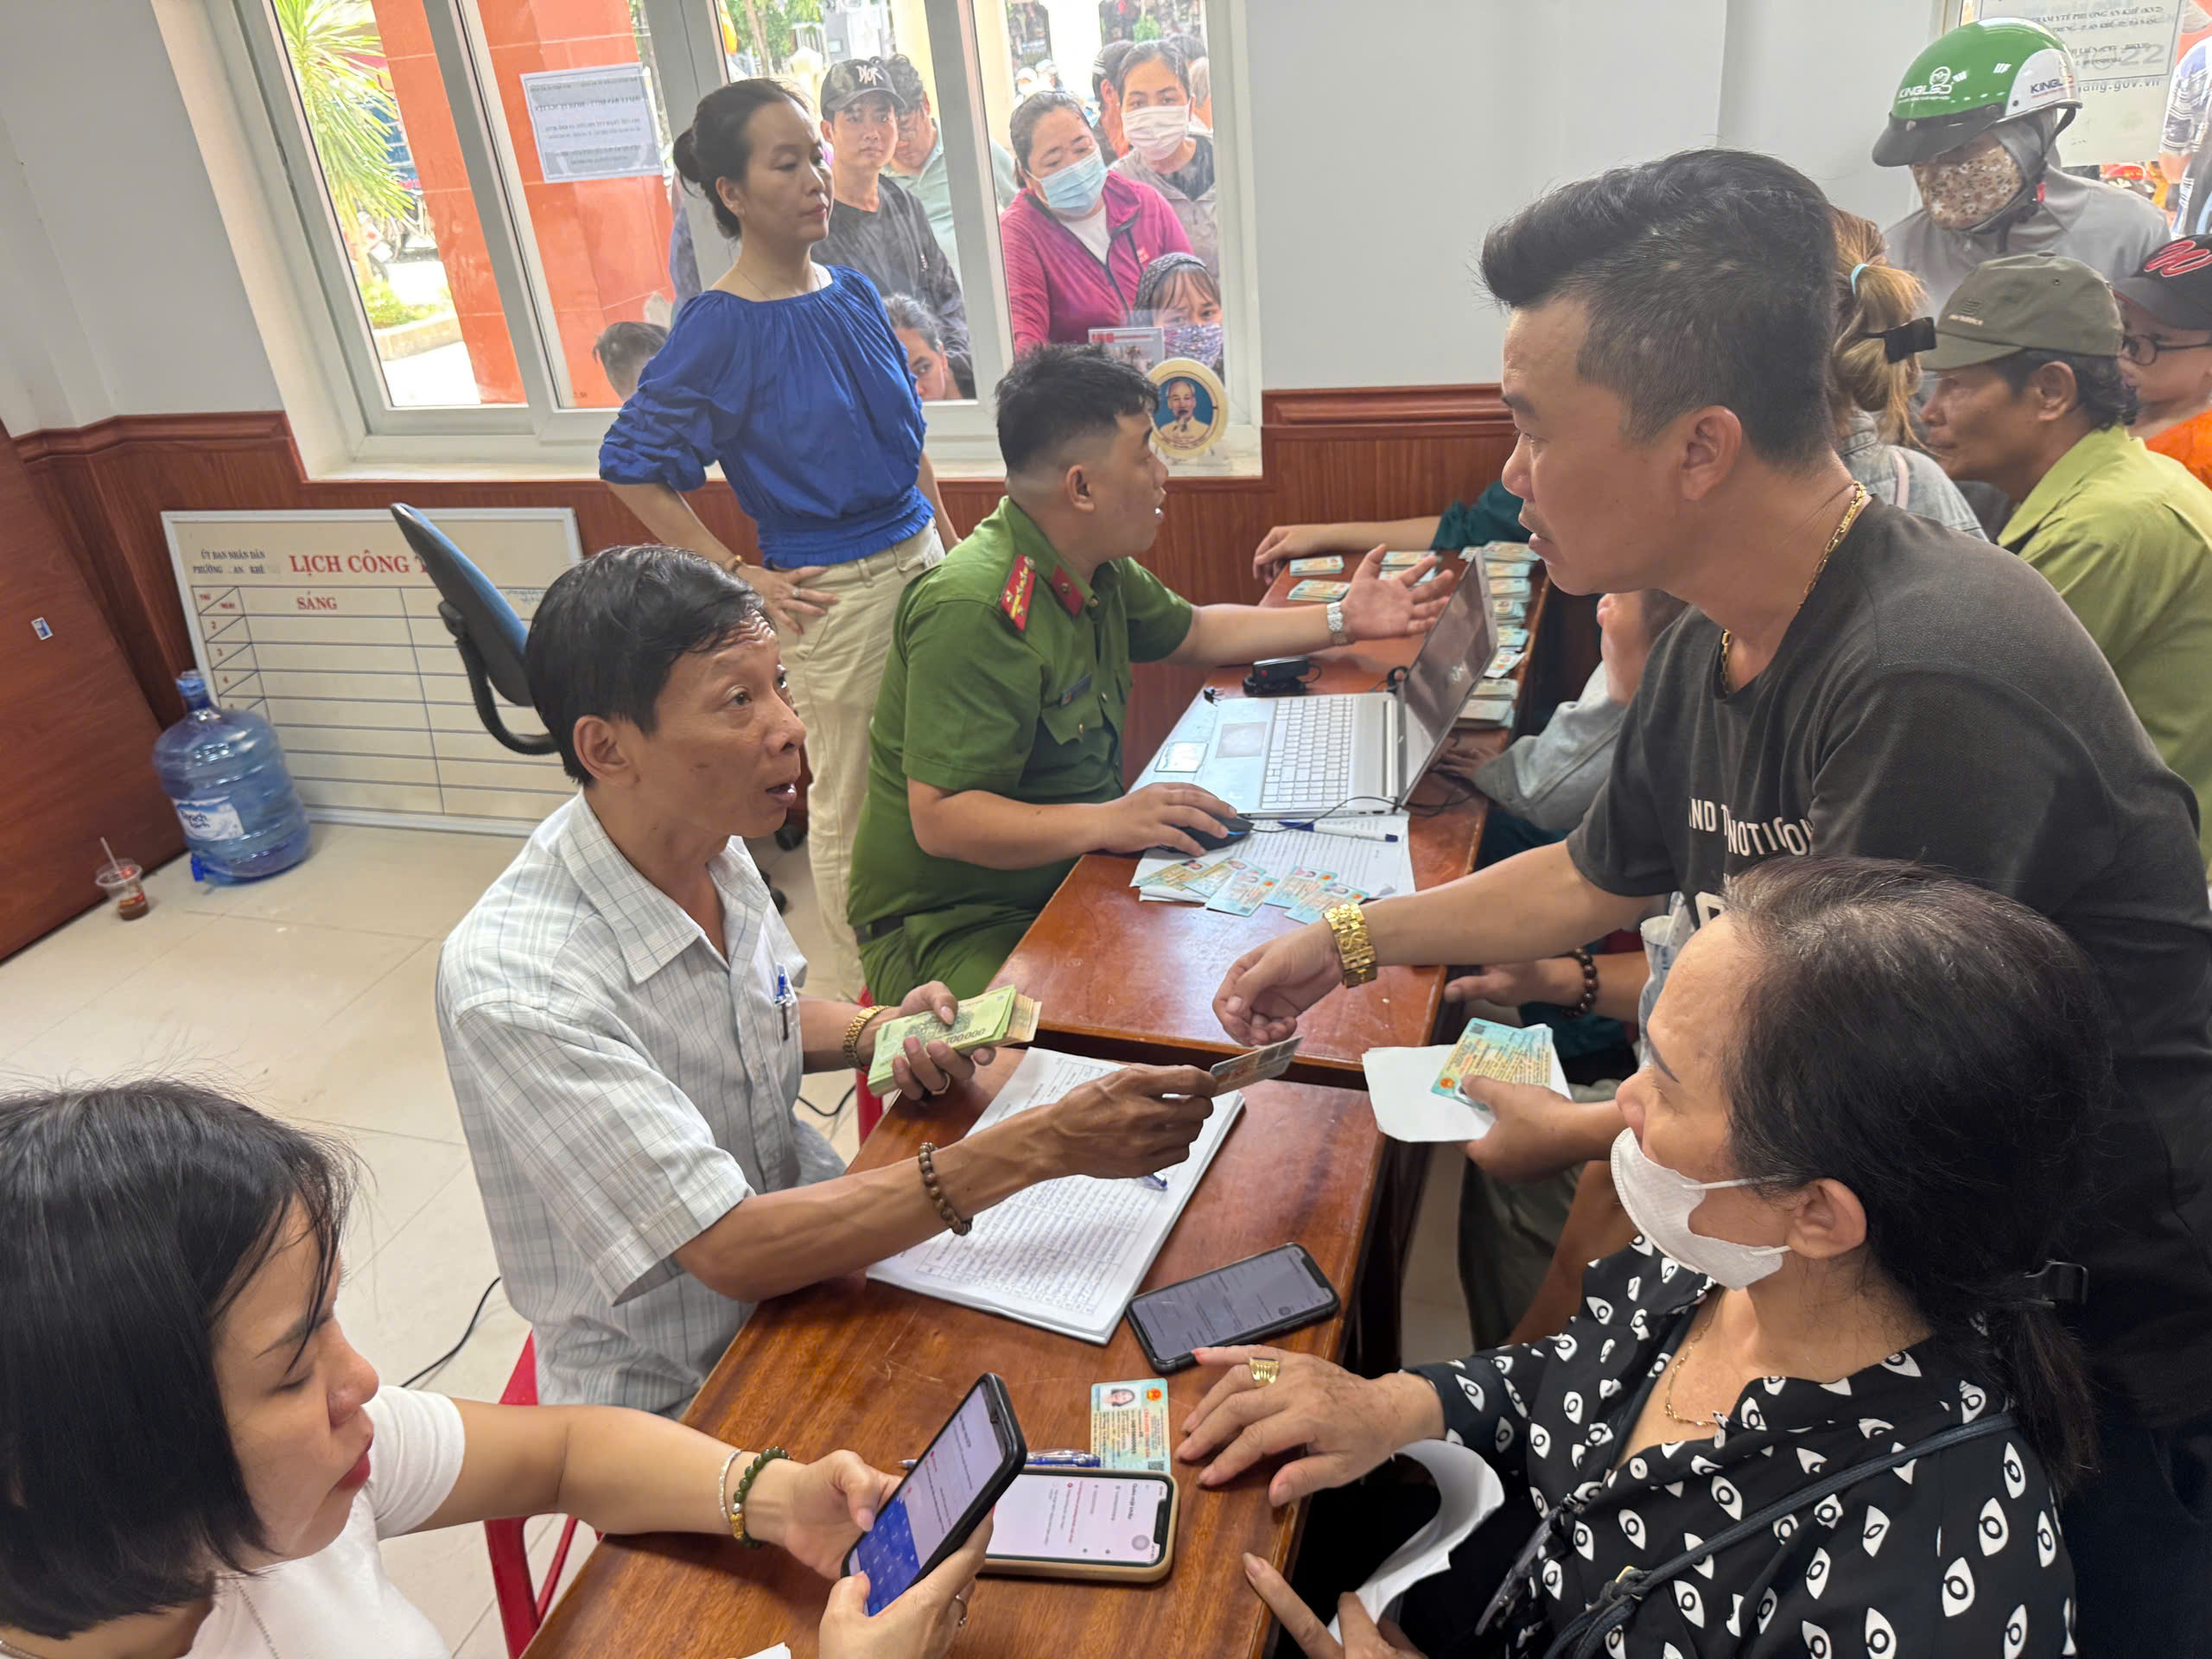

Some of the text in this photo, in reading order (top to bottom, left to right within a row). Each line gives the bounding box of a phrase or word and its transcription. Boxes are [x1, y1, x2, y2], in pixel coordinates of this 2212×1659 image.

[289, 555, 343, 577] LỊCH
[347, 549, 410, 573] CÔNG
[296, 589, 338, 610] SÁNG
